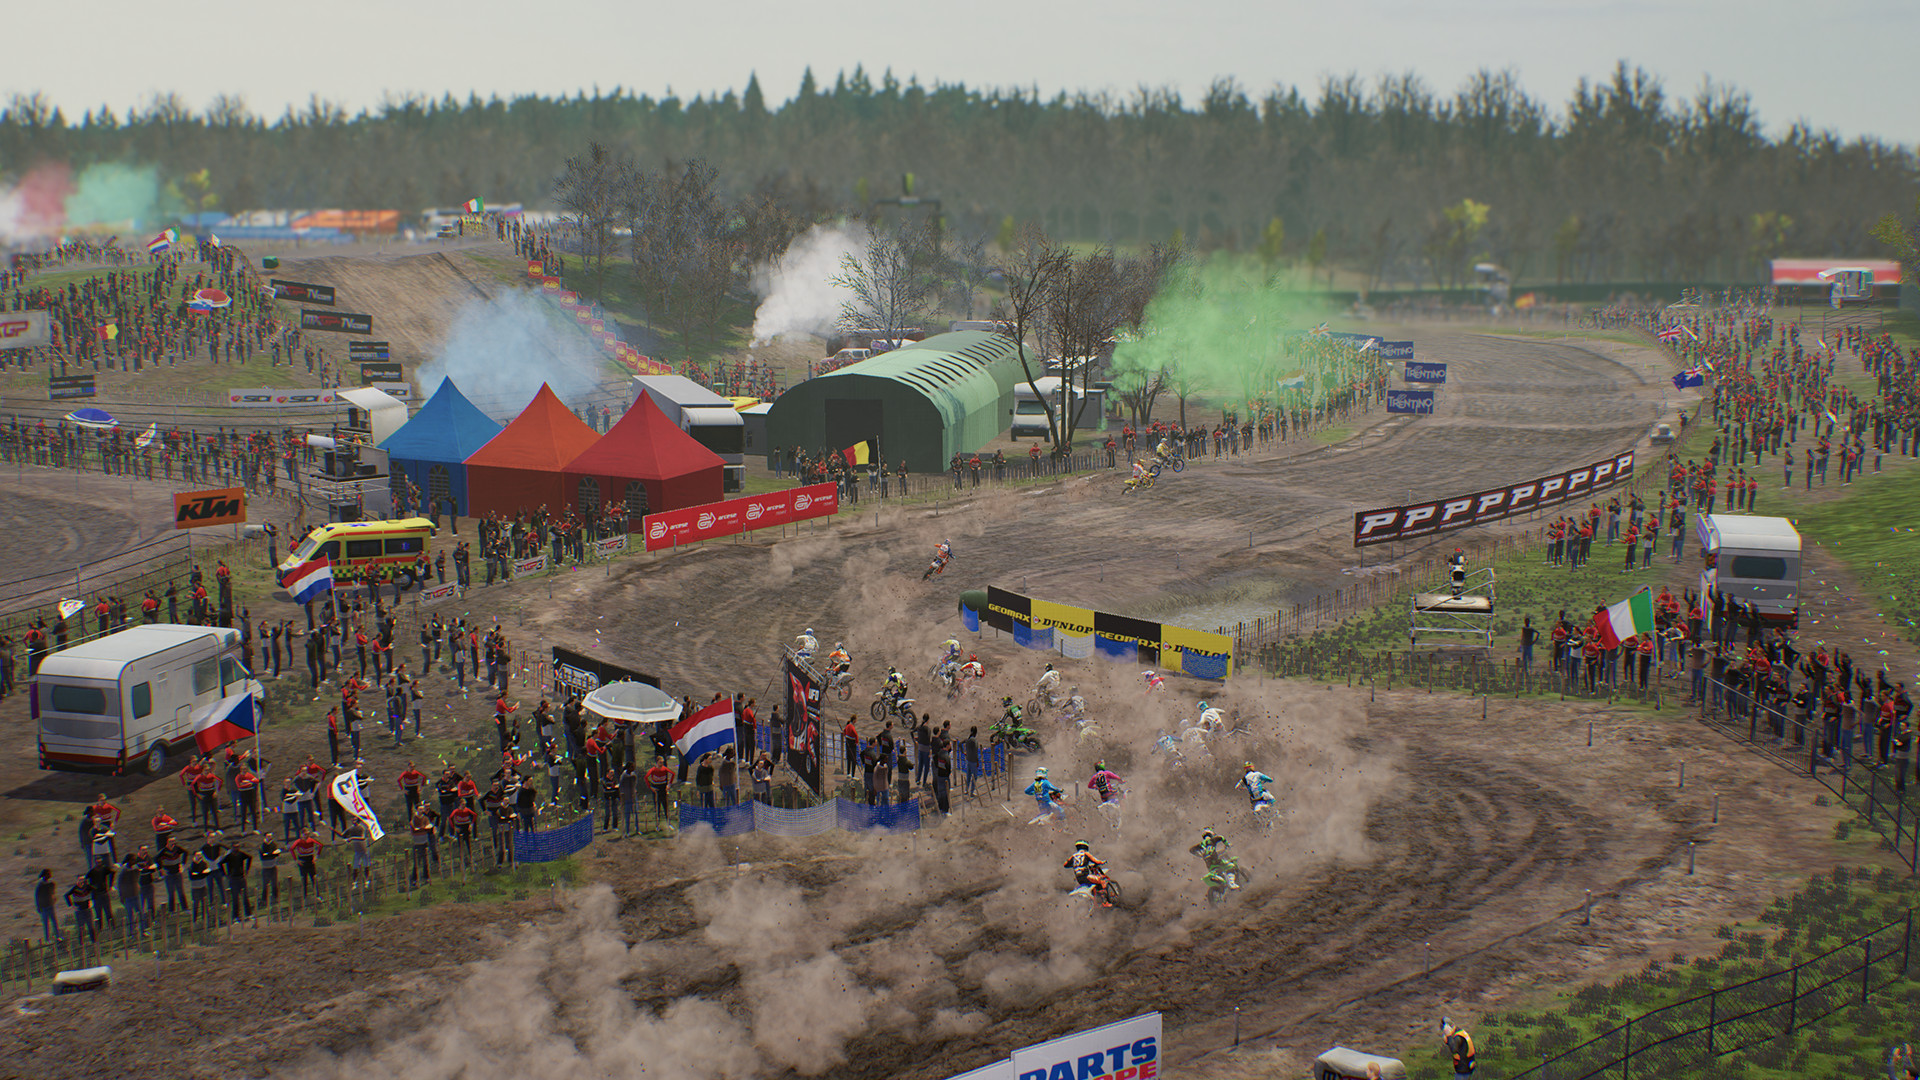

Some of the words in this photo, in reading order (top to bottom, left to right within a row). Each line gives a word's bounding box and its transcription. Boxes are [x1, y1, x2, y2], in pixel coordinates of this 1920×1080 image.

[177, 496, 240, 521] KTM
[1360, 512, 1398, 535] P
[1402, 506, 1436, 529] P
[1442, 499, 1472, 521] P
[1477, 492, 1506, 513] P
[1510, 485, 1536, 506] P
[1540, 477, 1564, 498] P
[1568, 470, 1590, 490] P
[1593, 462, 1613, 482] P
[1615, 454, 1633, 474] P
[988, 603, 1031, 623] GEOMAX
[1042, 618, 1093, 634] DUNLOP
